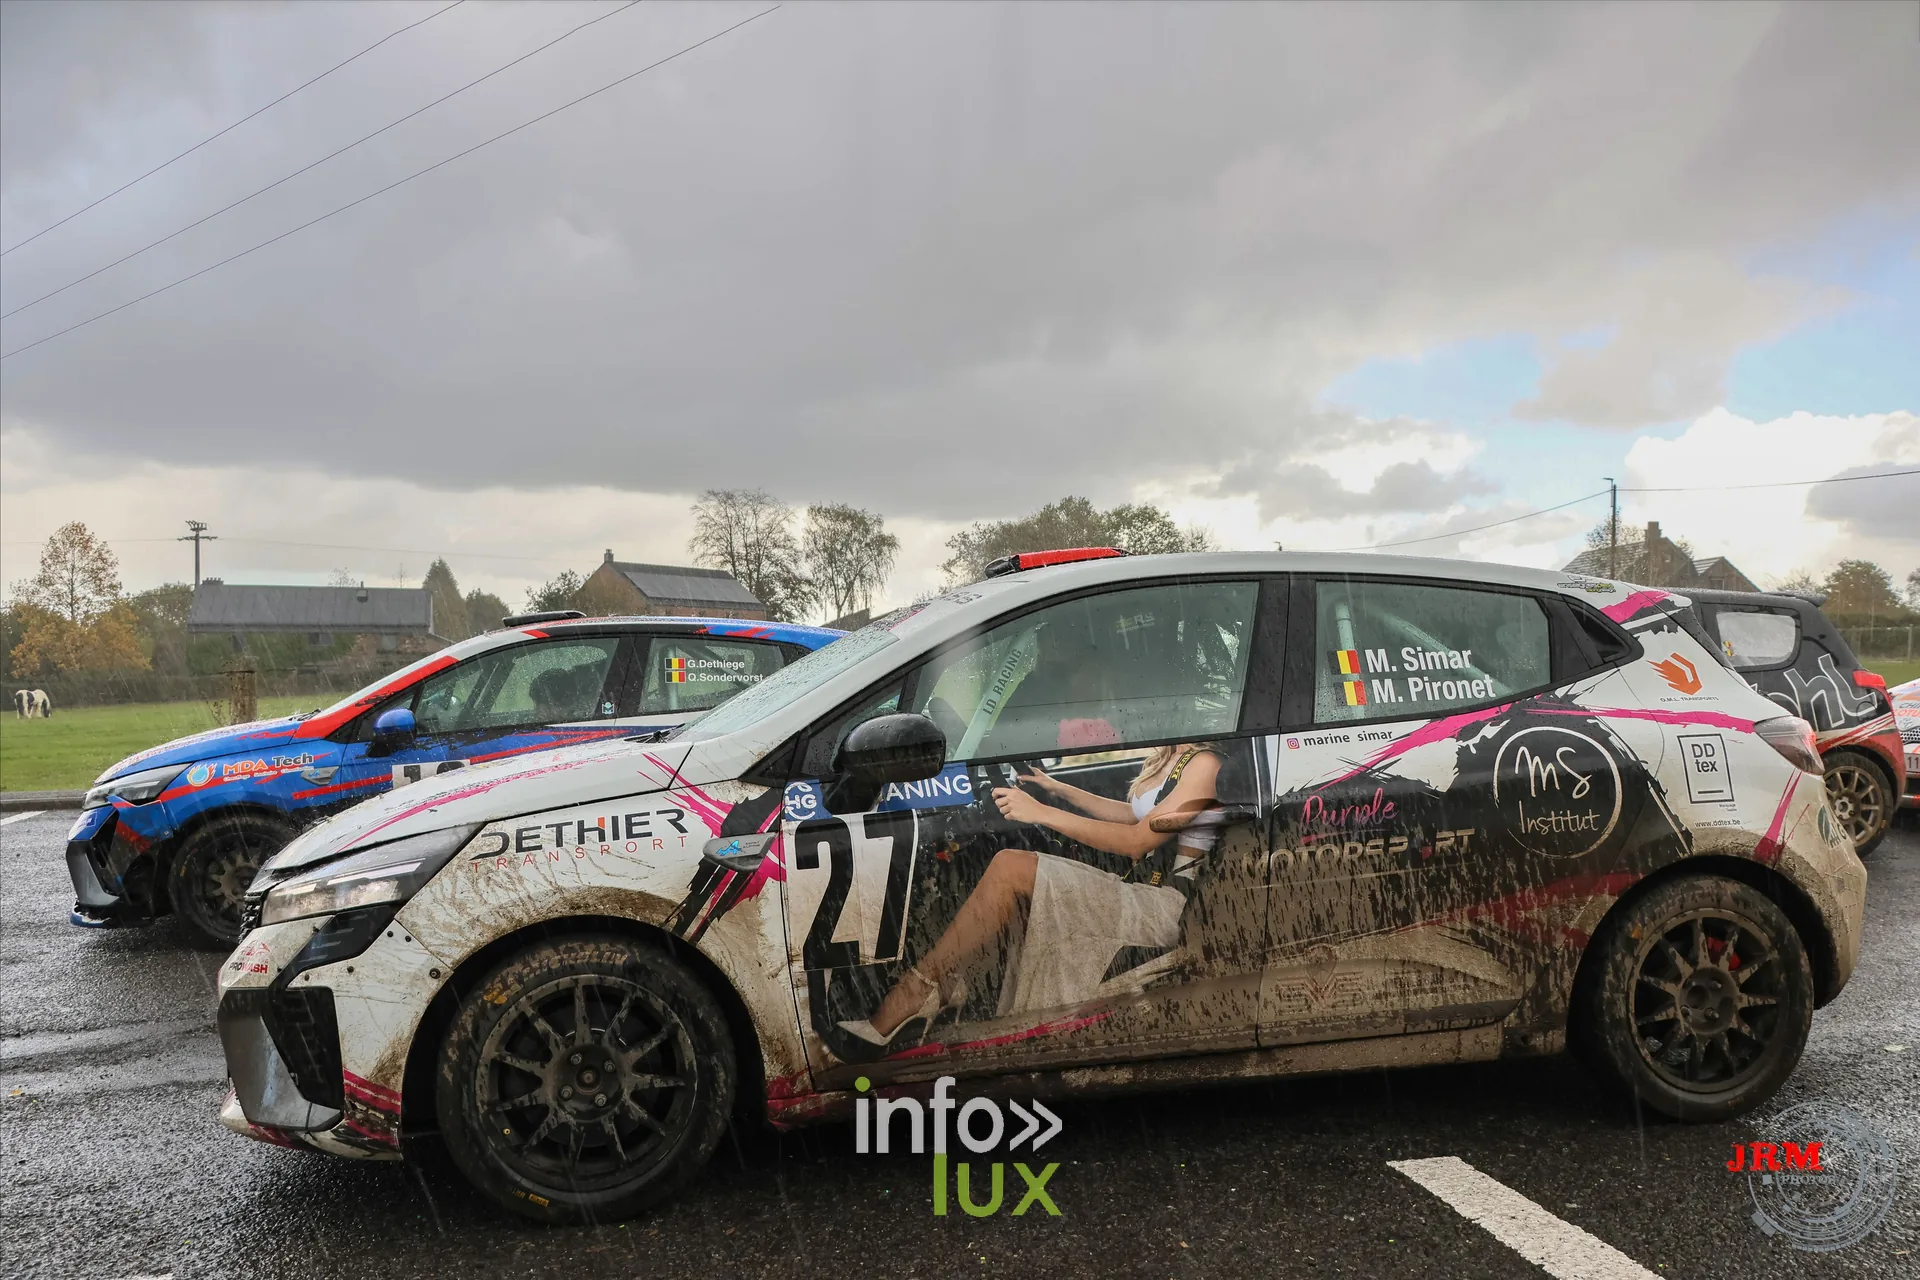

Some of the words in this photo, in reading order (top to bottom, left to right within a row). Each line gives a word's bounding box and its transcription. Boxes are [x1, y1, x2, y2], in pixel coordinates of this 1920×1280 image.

[687, 660, 745, 670] G.Dethiege
[1364, 649, 1397, 673] M.
[1401, 646, 1471, 672] Simar
[687, 673, 763, 682] Q.Sondervorst
[983, 698, 997, 715] LD
[992, 648, 1022, 695] RACING
[1371, 679, 1404, 704] M.
[1407, 674, 1496, 702] Pironet
[1303, 733, 1350, 746] marine
[1357, 730, 1393, 742] simar
[1691, 743, 1716, 758] DD
[223, 759, 268, 775] MDA
[272, 752, 314, 768] Tech
[1694, 759, 1718, 773] tex
[886, 774, 972, 801] ANING
[785, 795, 817, 809] HG
[1301, 787, 1399, 832] Purple
[1519, 800, 1600, 835] Institut
[1694, 819, 1740, 828] www.ddtex.be
[469, 809, 689, 861] DETHIER
[471, 836, 687, 873] TRANSPORT
[795, 811, 915, 970] 27
